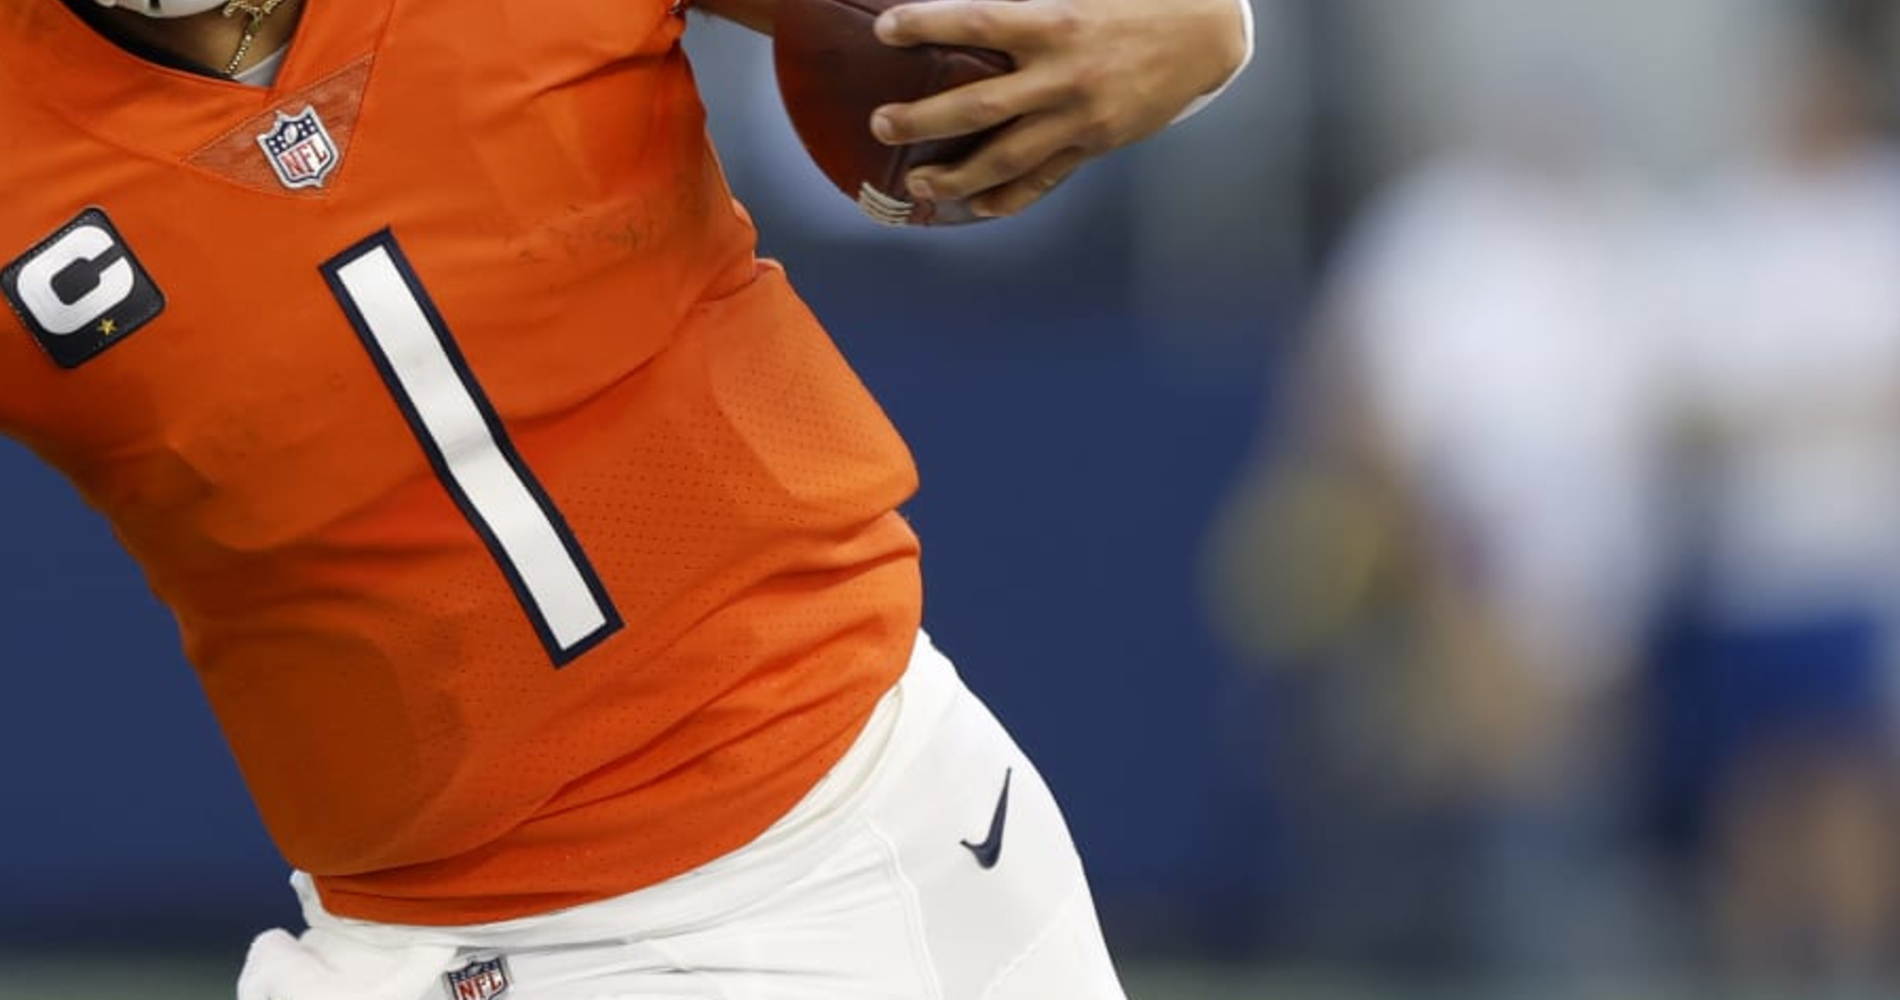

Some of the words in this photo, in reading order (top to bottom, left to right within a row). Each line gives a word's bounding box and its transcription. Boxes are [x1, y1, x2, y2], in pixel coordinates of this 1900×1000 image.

[280, 140, 328, 177] NFL
[17, 225, 134, 335] C
[318, 226, 625, 669] 1
